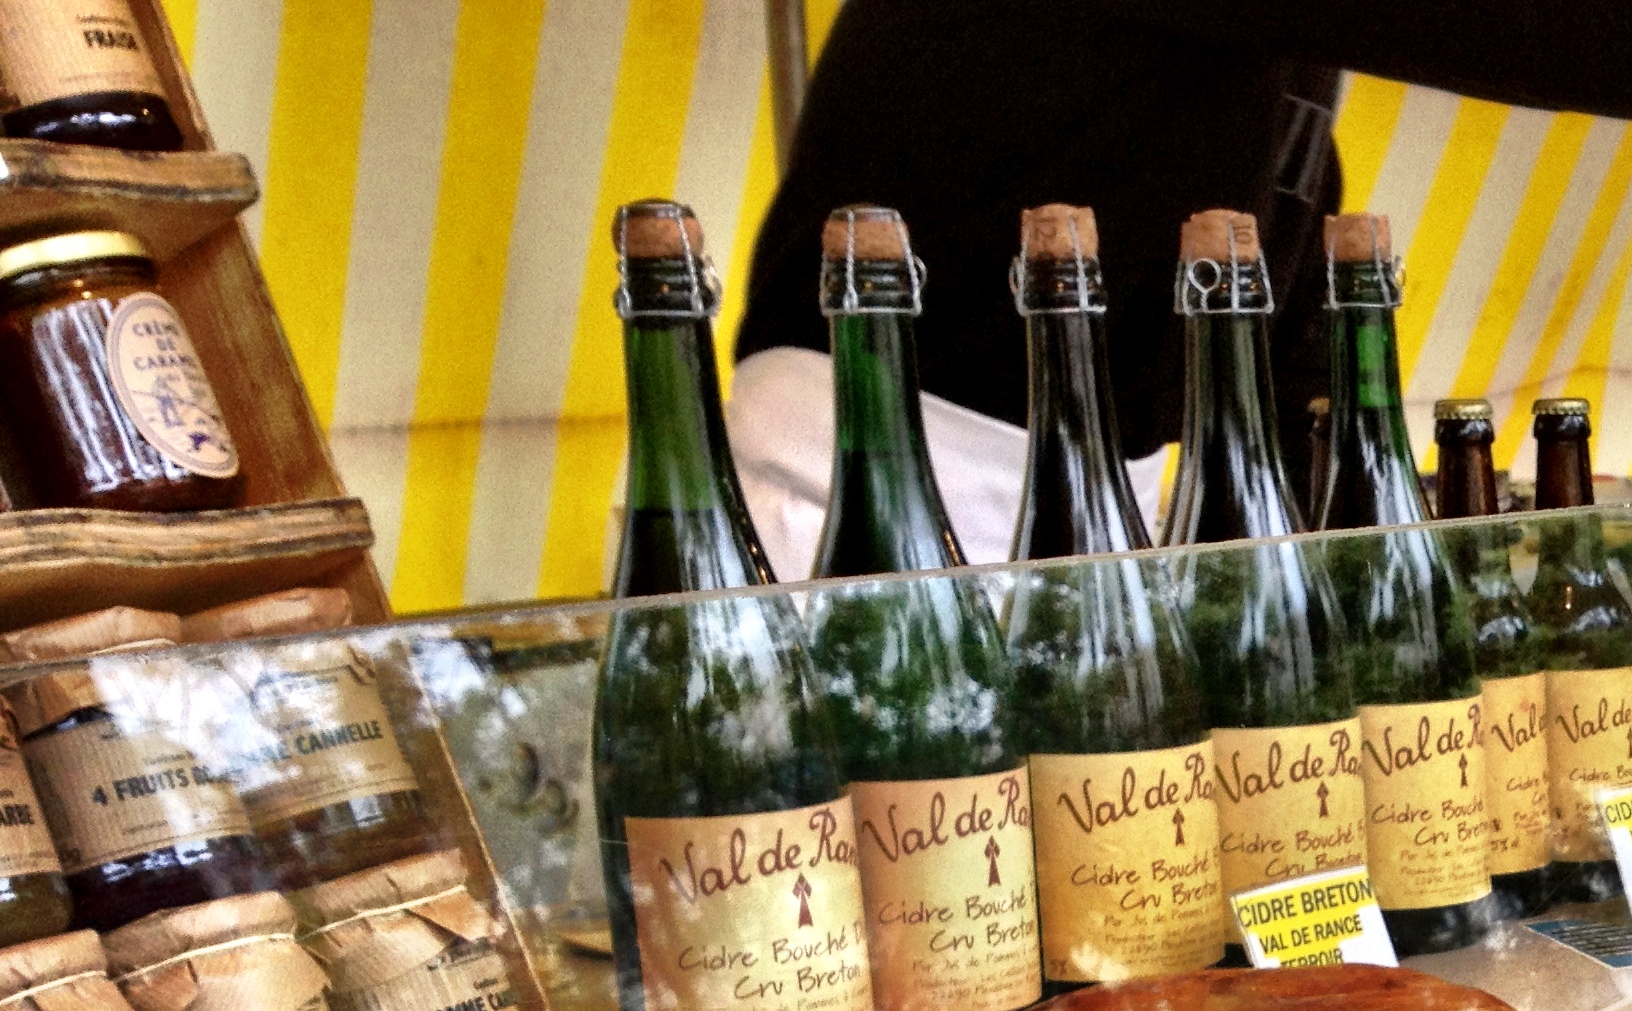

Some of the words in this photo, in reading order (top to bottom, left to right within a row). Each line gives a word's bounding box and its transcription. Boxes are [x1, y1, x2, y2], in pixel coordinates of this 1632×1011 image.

[295, 720, 382, 756] CANNELLE
[1491, 703, 1537, 753] Val
[1556, 697, 1609, 744] Val
[1612, 699, 1632, 728] de
[1215, 741, 1284, 803] Val
[1289, 743, 1324, 782] de
[1329, 728, 1361, 777] Ra
[1361, 716, 1432, 777] Val
[1437, 718, 1464, 755] de
[91, 785, 108, 806] 4
[112, 767, 189, 801] FRUITS
[1057, 766, 1138, 834] Val
[1144, 769, 1179, 810] de
[1184, 752, 1214, 803] Ra
[862, 791, 949, 863] Val
[955, 793, 993, 838] de
[1371, 803, 1432, 825] Cidre
[1221, 832, 1285, 854] Cidre
[659, 827, 751, 904] Val
[758, 828, 803, 877] de
[1071, 864, 1141, 887] Cidre
[878, 901, 954, 925] Cidre
[966, 886, 1026, 921] Bouché
[1120, 889, 1161, 911] Cru
[1238, 894, 1298, 928] CIDRE
[1300, 880, 1373, 918] BRETON
[678, 945, 759, 972] Cidre
[773, 926, 849, 965] Bouché
[929, 930, 974, 952] Cru
[1259, 930, 1288, 955] VAL
[1292, 923, 1311, 947] DE
[1315, 914, 1364, 942] RANCE
[734, 976, 783, 1000] Cru
